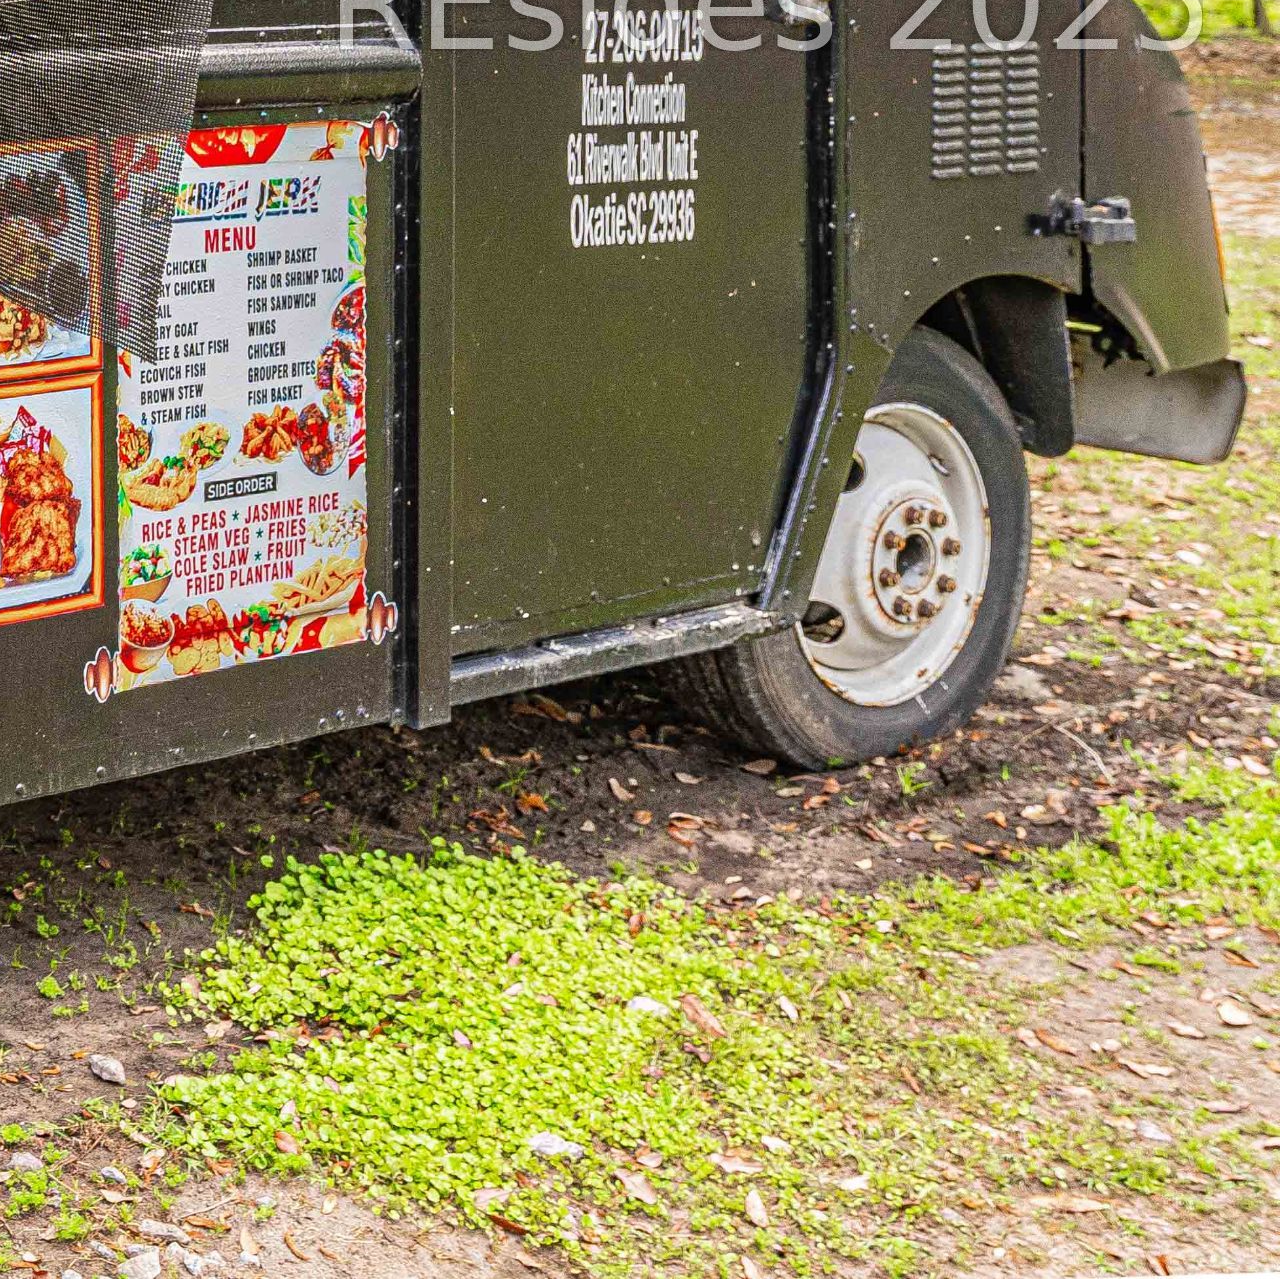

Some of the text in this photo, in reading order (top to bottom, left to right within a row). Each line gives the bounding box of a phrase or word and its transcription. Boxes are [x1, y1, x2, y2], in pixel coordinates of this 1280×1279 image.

[582, 71, 686, 126] Kitchen Connection
[567, 129, 699, 186] 61 Riverwalk Blvd Unit E
[255, 175, 321, 221] JERK
[648, 188, 695, 244] 29936
[204, 226, 257, 253] MENU
[165, 259, 207, 277] CHICKEN
[247, 247, 317, 268] SHRIMP BASKET
[174, 279, 215, 296] CHICKEN
[247, 267, 344, 291] FISH OR SHRIMP TACO
[247, 293, 316, 315] FISH SANDWICH
[174, 322, 199, 338] GOAT
[247, 319, 276, 337] WINGS
[173, 338, 229, 359] & SALT FISH
[247, 341, 286, 360] CHICKEN
[140, 362, 206, 384] ECOVICH FISH
[248, 360, 316, 383] GROUPER BITES
[140, 384, 204, 406] BROWN STEW
[248, 385, 303, 406] FISH BASKET
[141, 404, 206, 426] & STEAM FISH
[207, 476, 273, 499] SIDE ORDER
[142, 492, 339, 542] RICE & PEAS JASMINE RICE
[174, 519, 306, 557] STEAM VEG FRIES
[174, 538, 306, 578] COLE SLAW FRUIT
[186, 560, 294, 597] FRIED PLANTAIN
